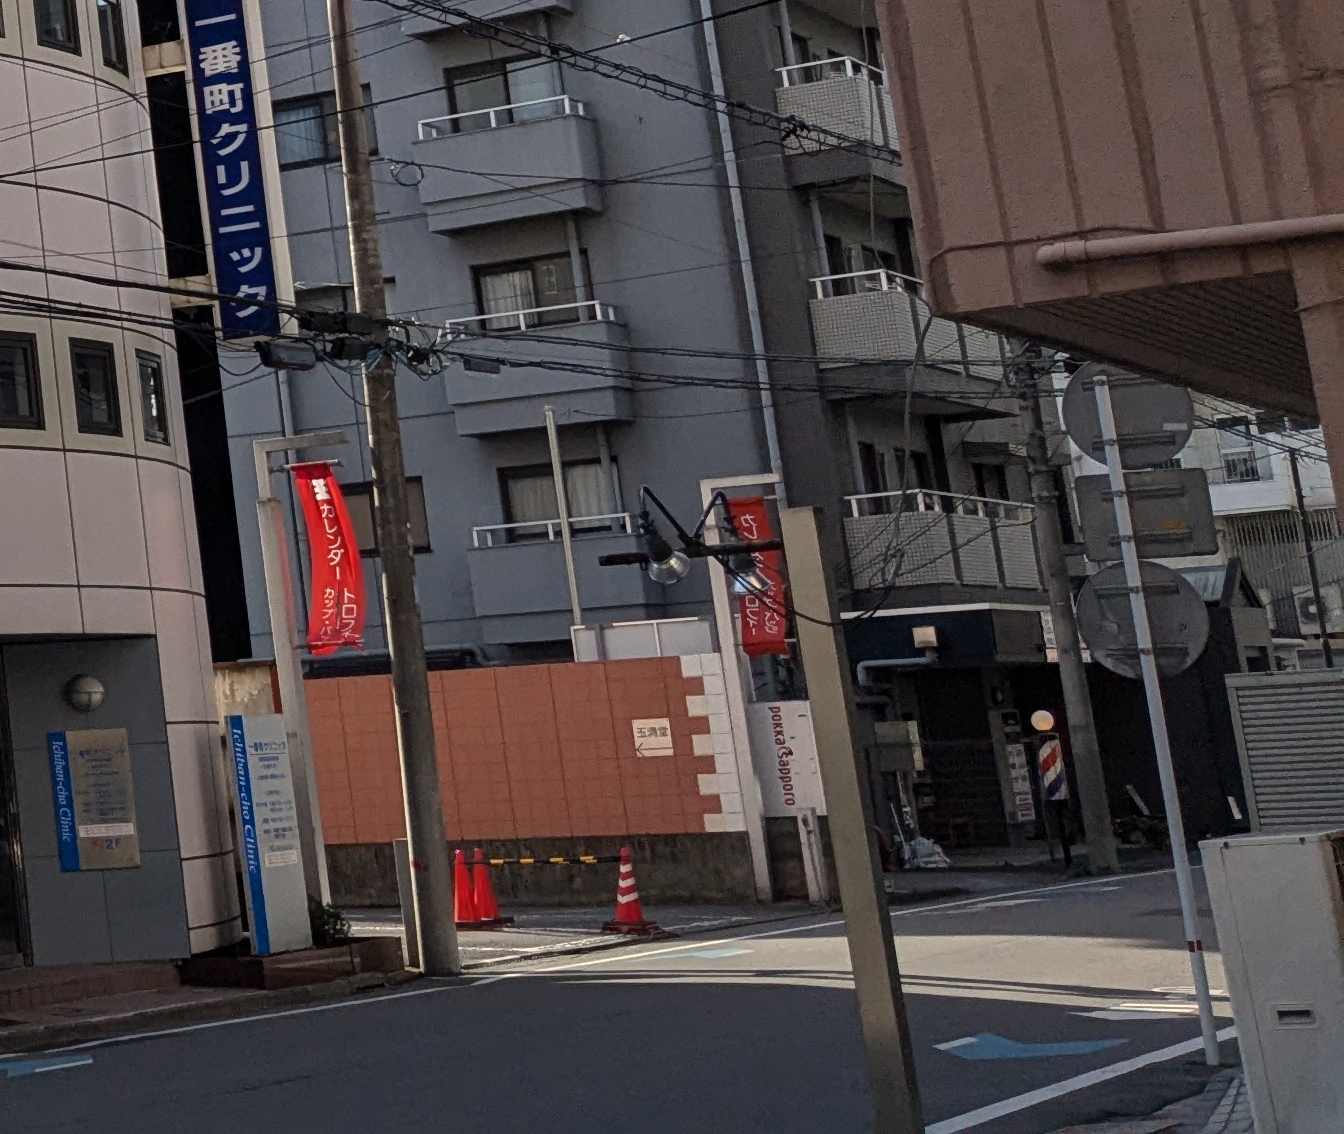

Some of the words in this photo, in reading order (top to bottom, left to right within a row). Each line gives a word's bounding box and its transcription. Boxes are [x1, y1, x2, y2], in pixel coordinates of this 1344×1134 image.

[195, 12, 269, 319] 一番町クリニック
[320, 503, 345, 580] カレンダー
[52, 741, 67, 805] Ichiban-cho
[233, 729, 251, 820] Ichiban-cho
[244, 824, 258, 875] Clinic
[59, 807, 73, 843] Clinic
